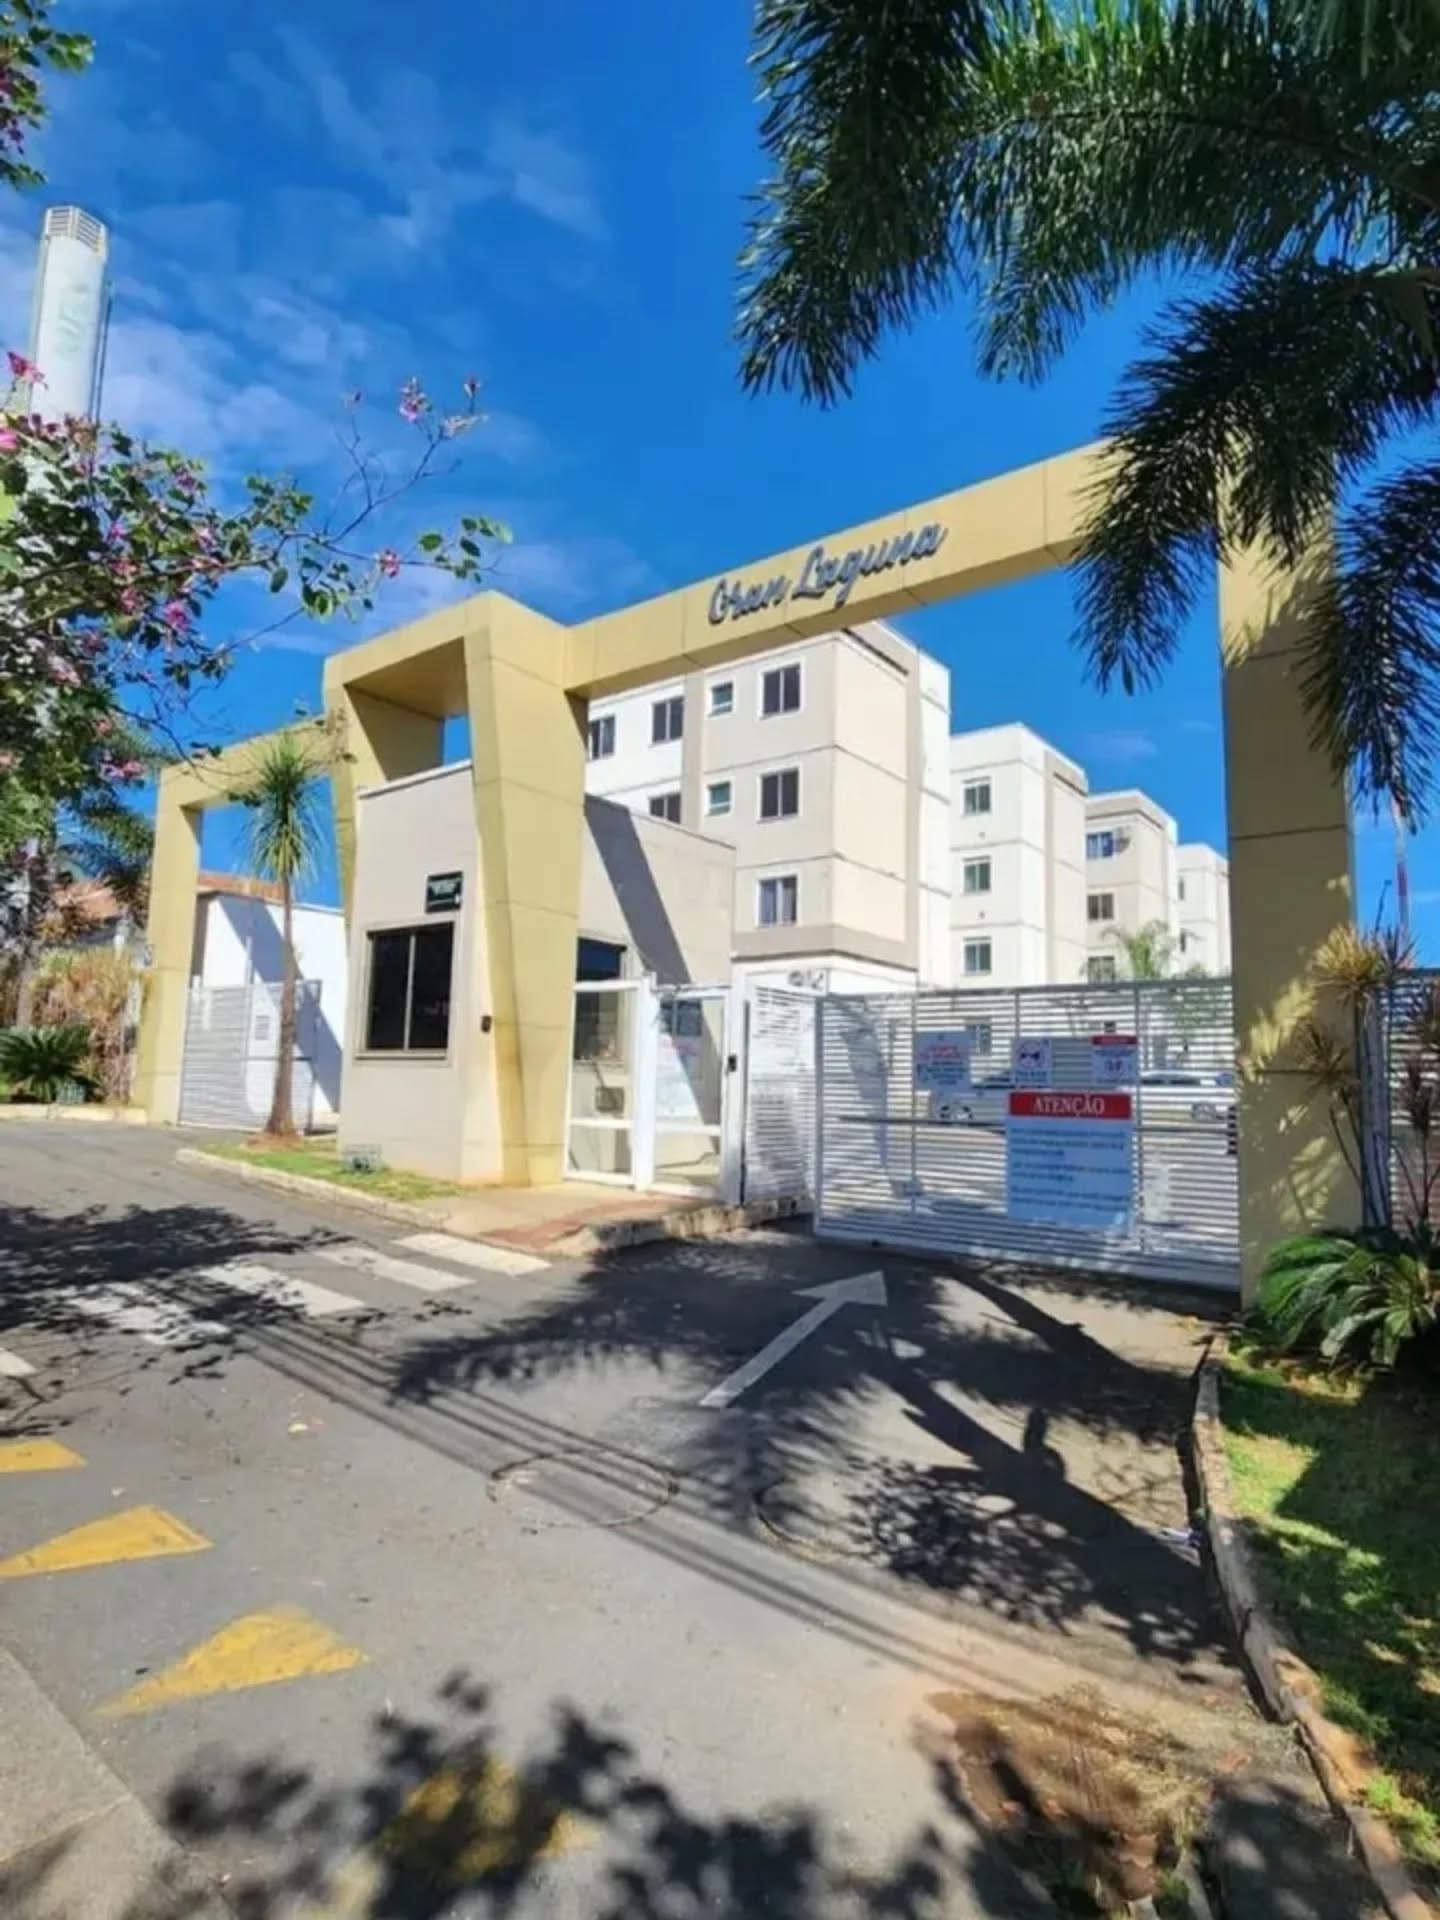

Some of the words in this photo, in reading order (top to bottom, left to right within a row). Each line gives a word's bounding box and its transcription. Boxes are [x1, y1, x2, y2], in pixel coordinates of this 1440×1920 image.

[708, 577, 791, 626] Gran
[791, 523, 948, 609] Laguna
[1032, 1093, 1106, 1117] ATENÇÃO
